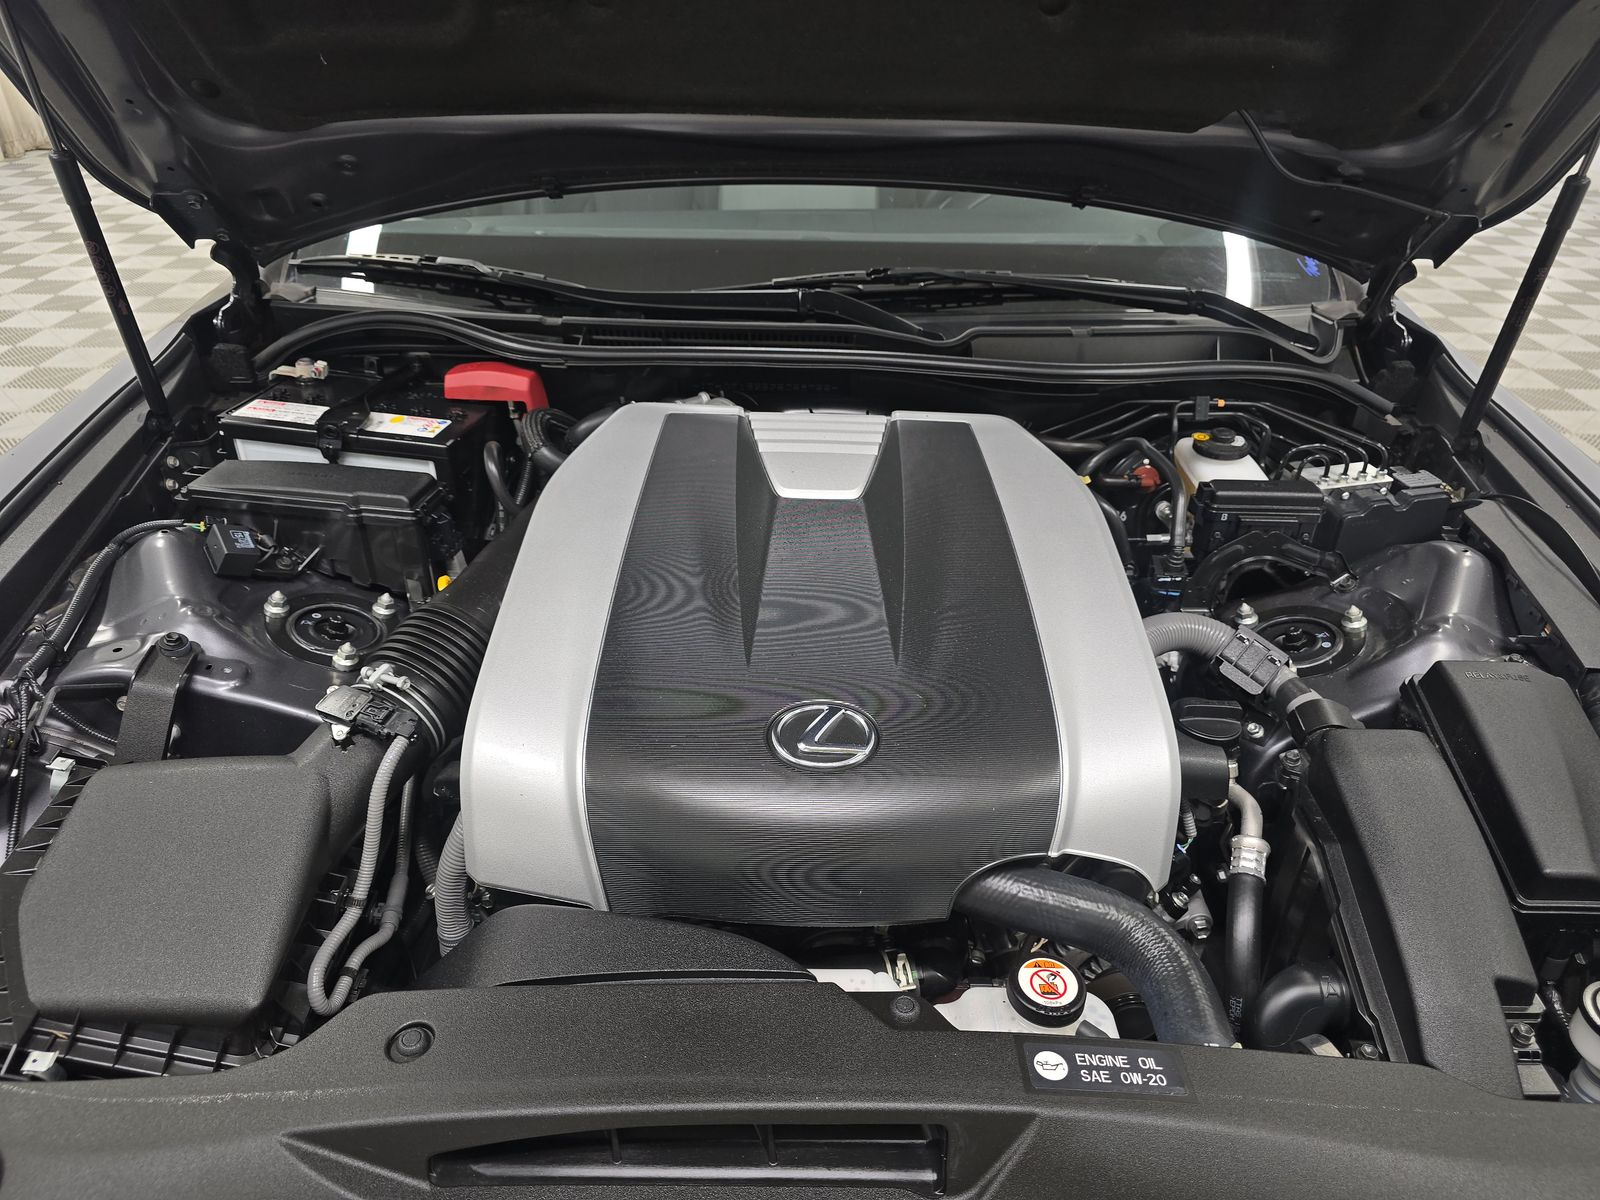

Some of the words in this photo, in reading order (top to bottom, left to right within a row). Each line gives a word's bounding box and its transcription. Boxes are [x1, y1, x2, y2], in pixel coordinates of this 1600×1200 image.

[1074, 1053, 1130, 1068] ENGINE
[1138, 1057, 1164, 1070] OIL
[1080, 1069, 1113, 1083] SAE
[1120, 1072, 1167, 1086] 0W-20
